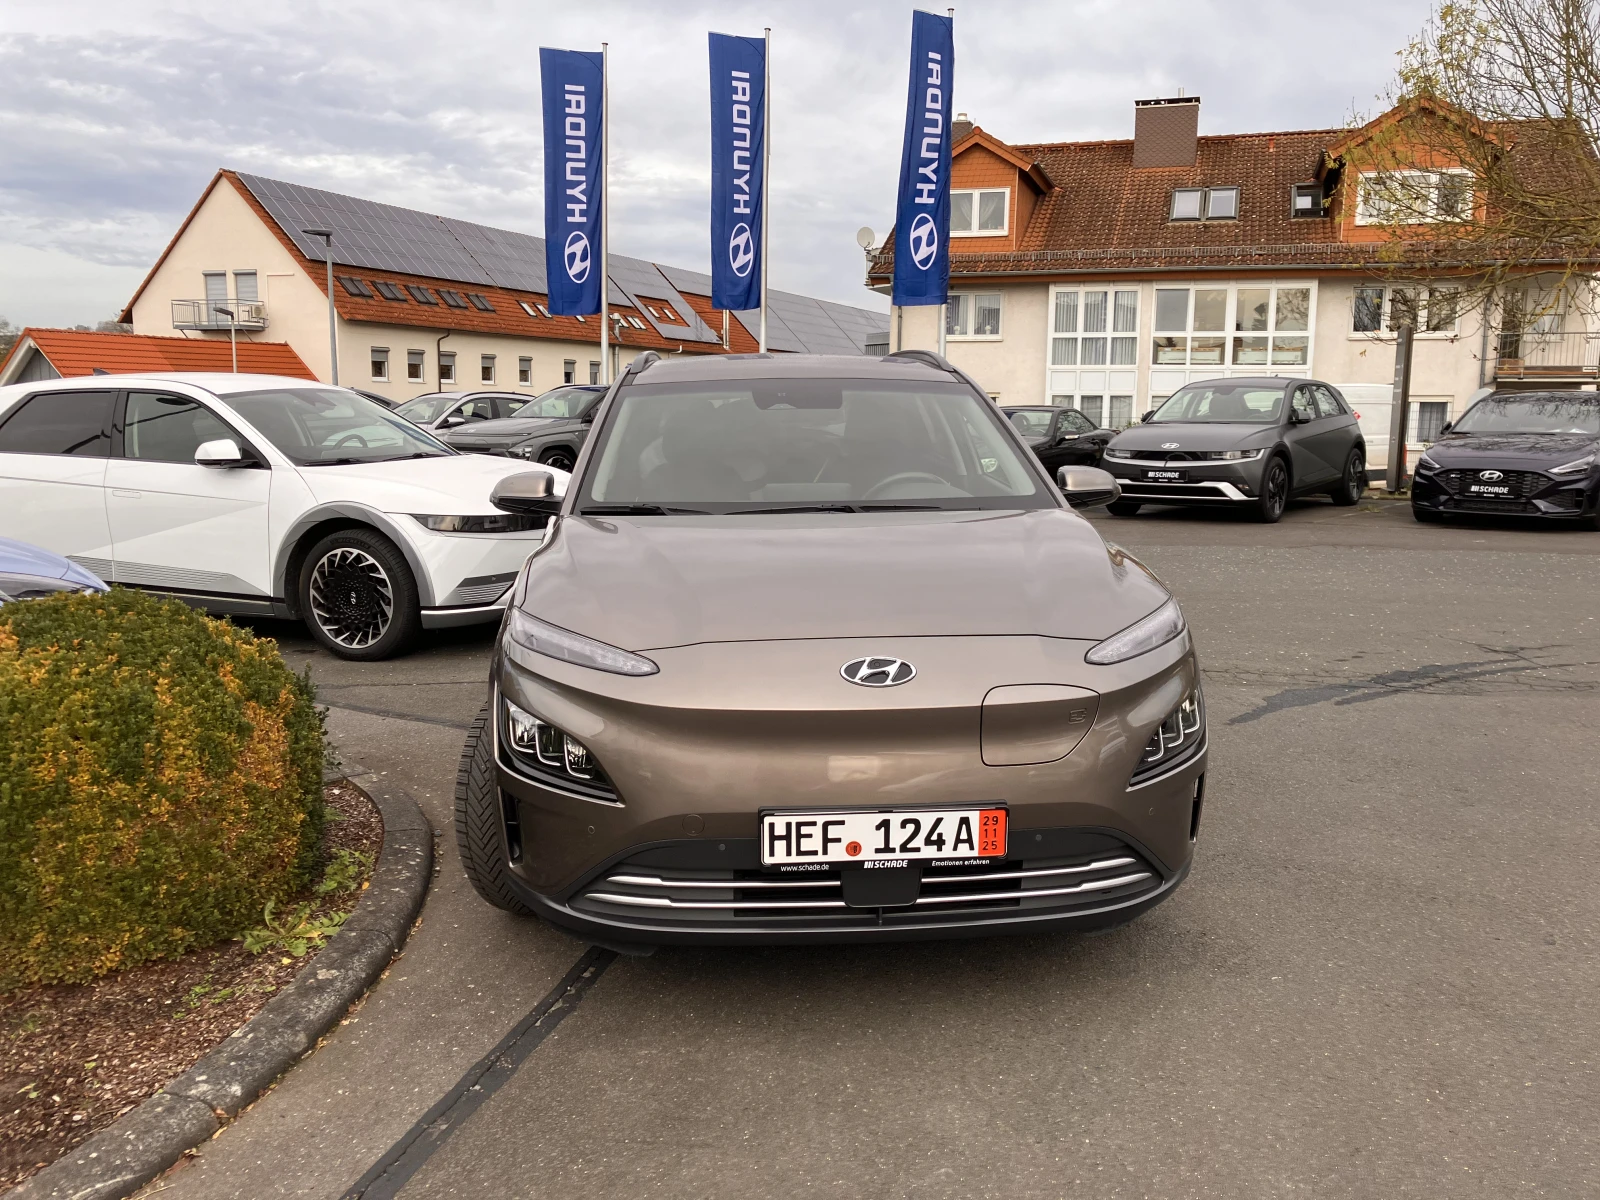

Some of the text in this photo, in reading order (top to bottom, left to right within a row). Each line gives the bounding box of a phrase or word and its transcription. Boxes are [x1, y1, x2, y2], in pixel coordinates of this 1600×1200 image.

[1480, 486, 1509, 494] SCHADE
[983, 815, 999, 826] 29
[768, 819, 846, 857] HEF
[984, 828, 997, 838] 11
[982, 840, 998, 851] 25
[780, 863, 830, 872] www.schade.de
[874, 860, 909, 869] SCHADE
